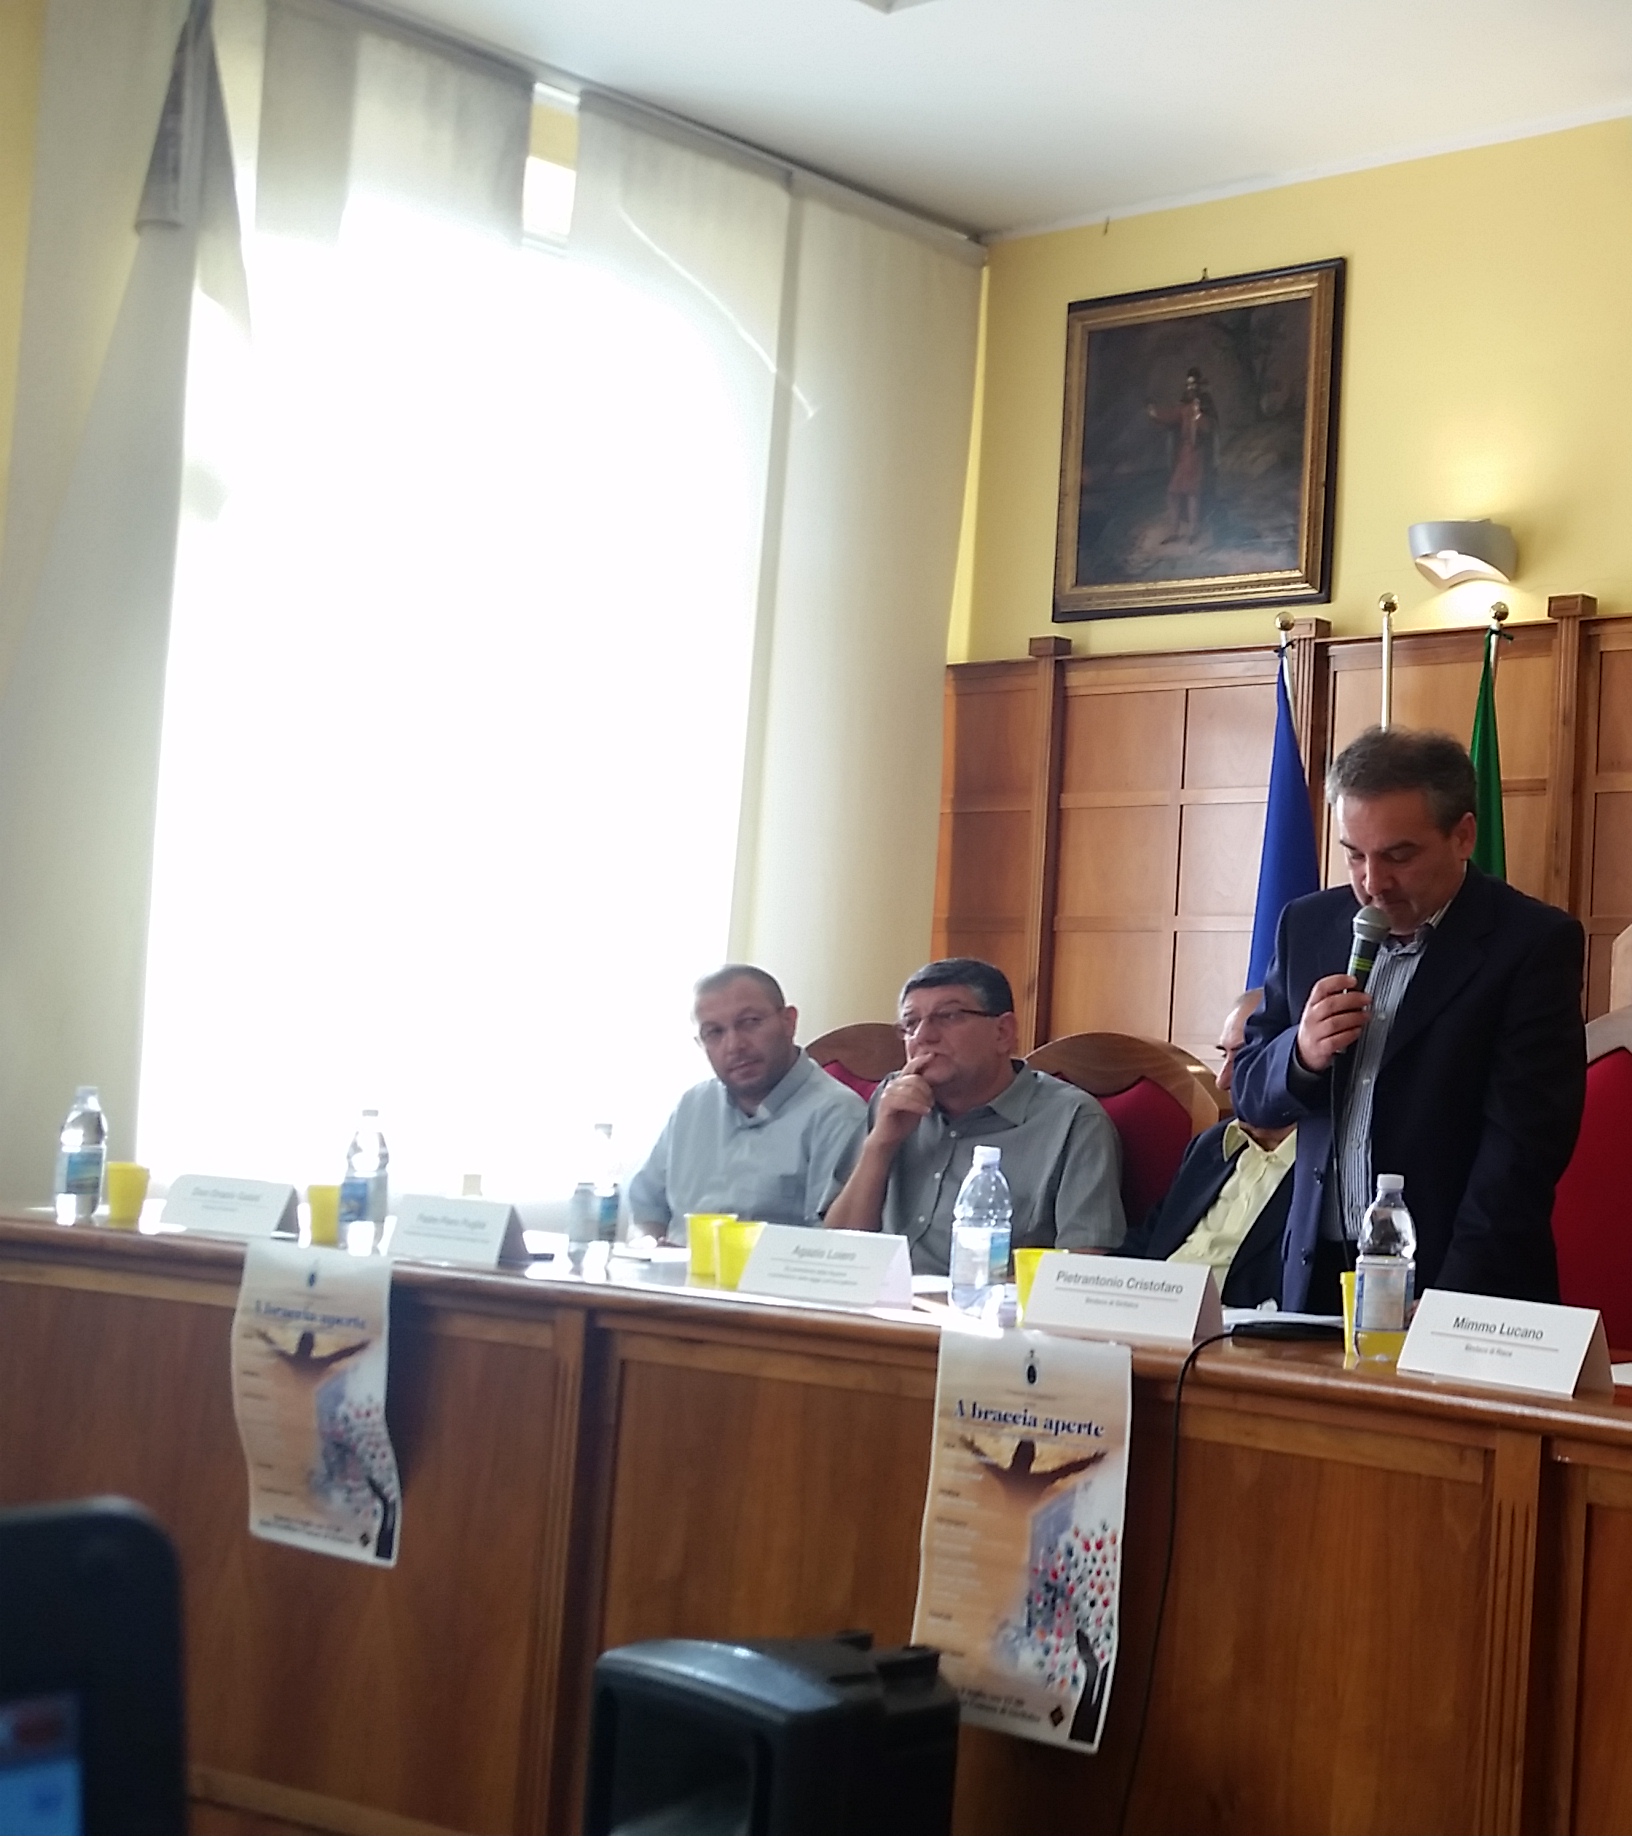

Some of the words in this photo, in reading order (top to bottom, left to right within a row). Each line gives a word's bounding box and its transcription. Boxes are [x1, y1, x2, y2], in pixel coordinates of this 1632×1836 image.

[1056, 1270, 1125, 1289] Pietrantonio
[1126, 1277, 1184, 1295] Cristofaro
[1453, 1316, 1497, 1334] Mimmo
[1499, 1322, 1544, 1340] Lucano
[971, 1400, 1038, 1428] braccia
[1043, 1416, 1105, 1438] aperte
